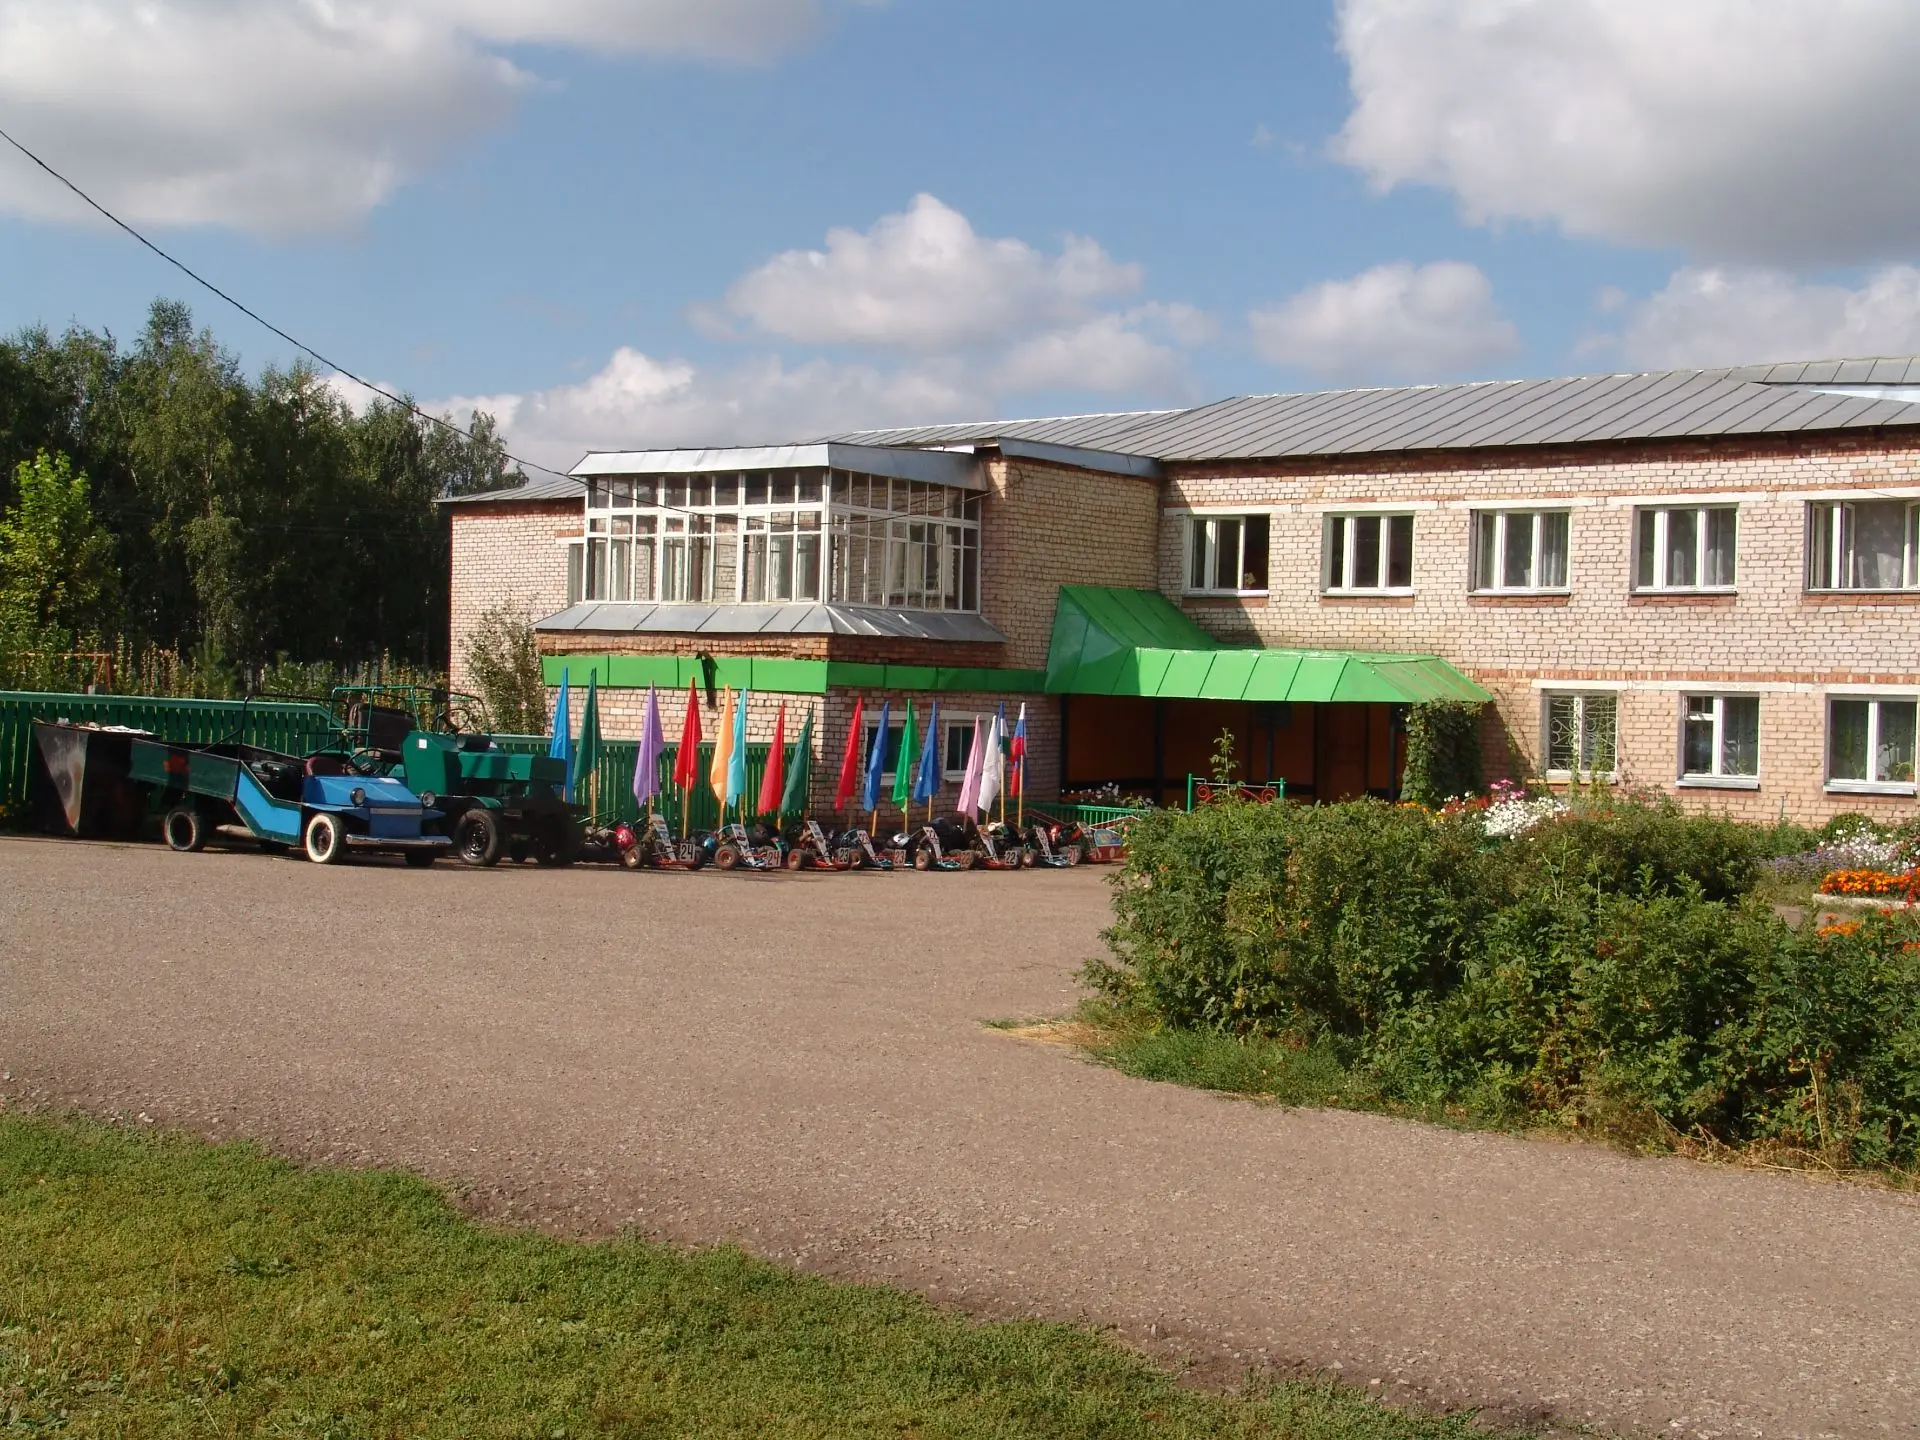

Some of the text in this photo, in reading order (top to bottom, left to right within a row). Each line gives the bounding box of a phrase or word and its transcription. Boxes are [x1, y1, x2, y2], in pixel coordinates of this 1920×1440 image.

[681, 844, 694, 860] 24
[768, 851, 780, 865] 24
[840, 848, 849, 863] 23
[895, 850, 904, 864] 23
[1005, 851, 1016, 864] 22
